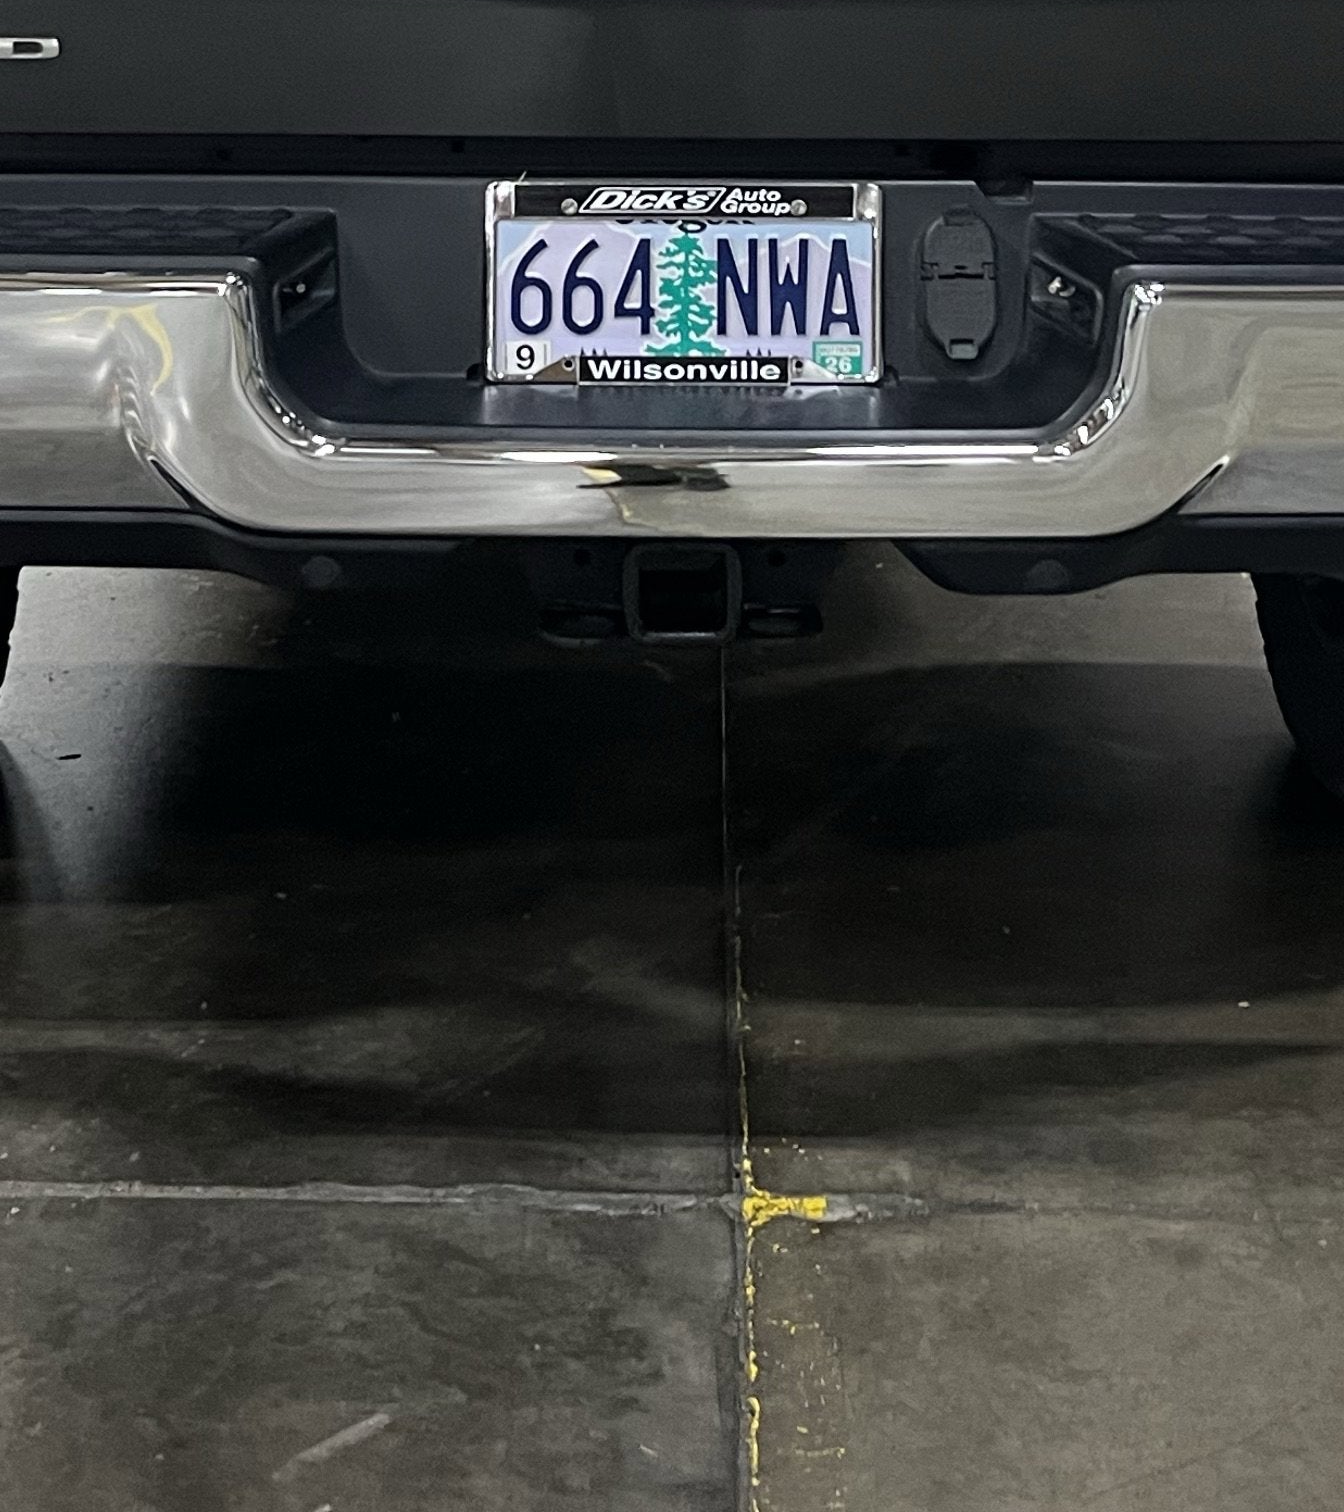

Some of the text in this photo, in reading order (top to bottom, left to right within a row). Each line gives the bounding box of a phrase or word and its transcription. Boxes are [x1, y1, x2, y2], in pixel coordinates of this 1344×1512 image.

[589, 189, 710, 210] Dick's
[725, 188, 782, 202] Auto
[719, 199, 792, 216] Group
[511, 238, 860, 336] 664 NWA
[516, 345, 535, 370] 9
[824, 356, 853, 374] 26
[588, 359, 781, 381] Wilsonville
